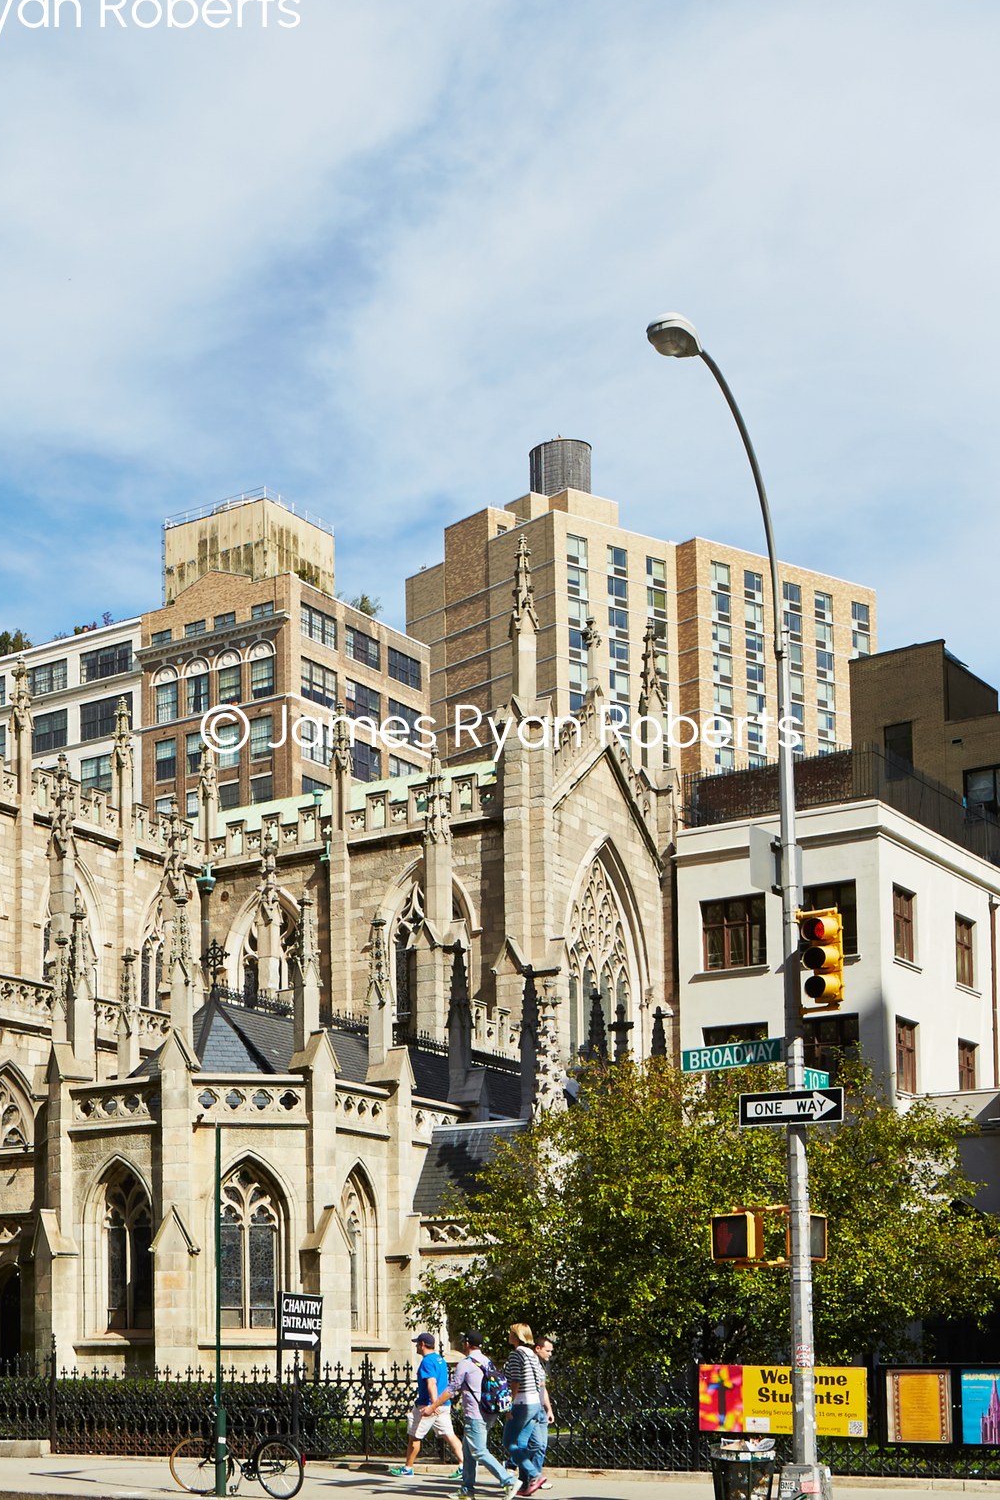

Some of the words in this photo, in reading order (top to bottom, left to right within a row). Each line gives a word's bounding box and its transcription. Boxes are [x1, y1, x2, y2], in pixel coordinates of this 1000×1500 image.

[689, 1042, 775, 1070] BROADWAY
[808, 1072, 819, 1089] 10
[820, 1074, 827, 1085] ST
[754, 1102, 783, 1116] ONE
[796, 1099, 827, 1113] WAY
[283, 1298, 322, 1315] CHANTRY
[282, 1315, 322, 1330] ENTRANCE
[760, 1369, 848, 1386] Welme
[757, 1386, 850, 1405] Stunts!
